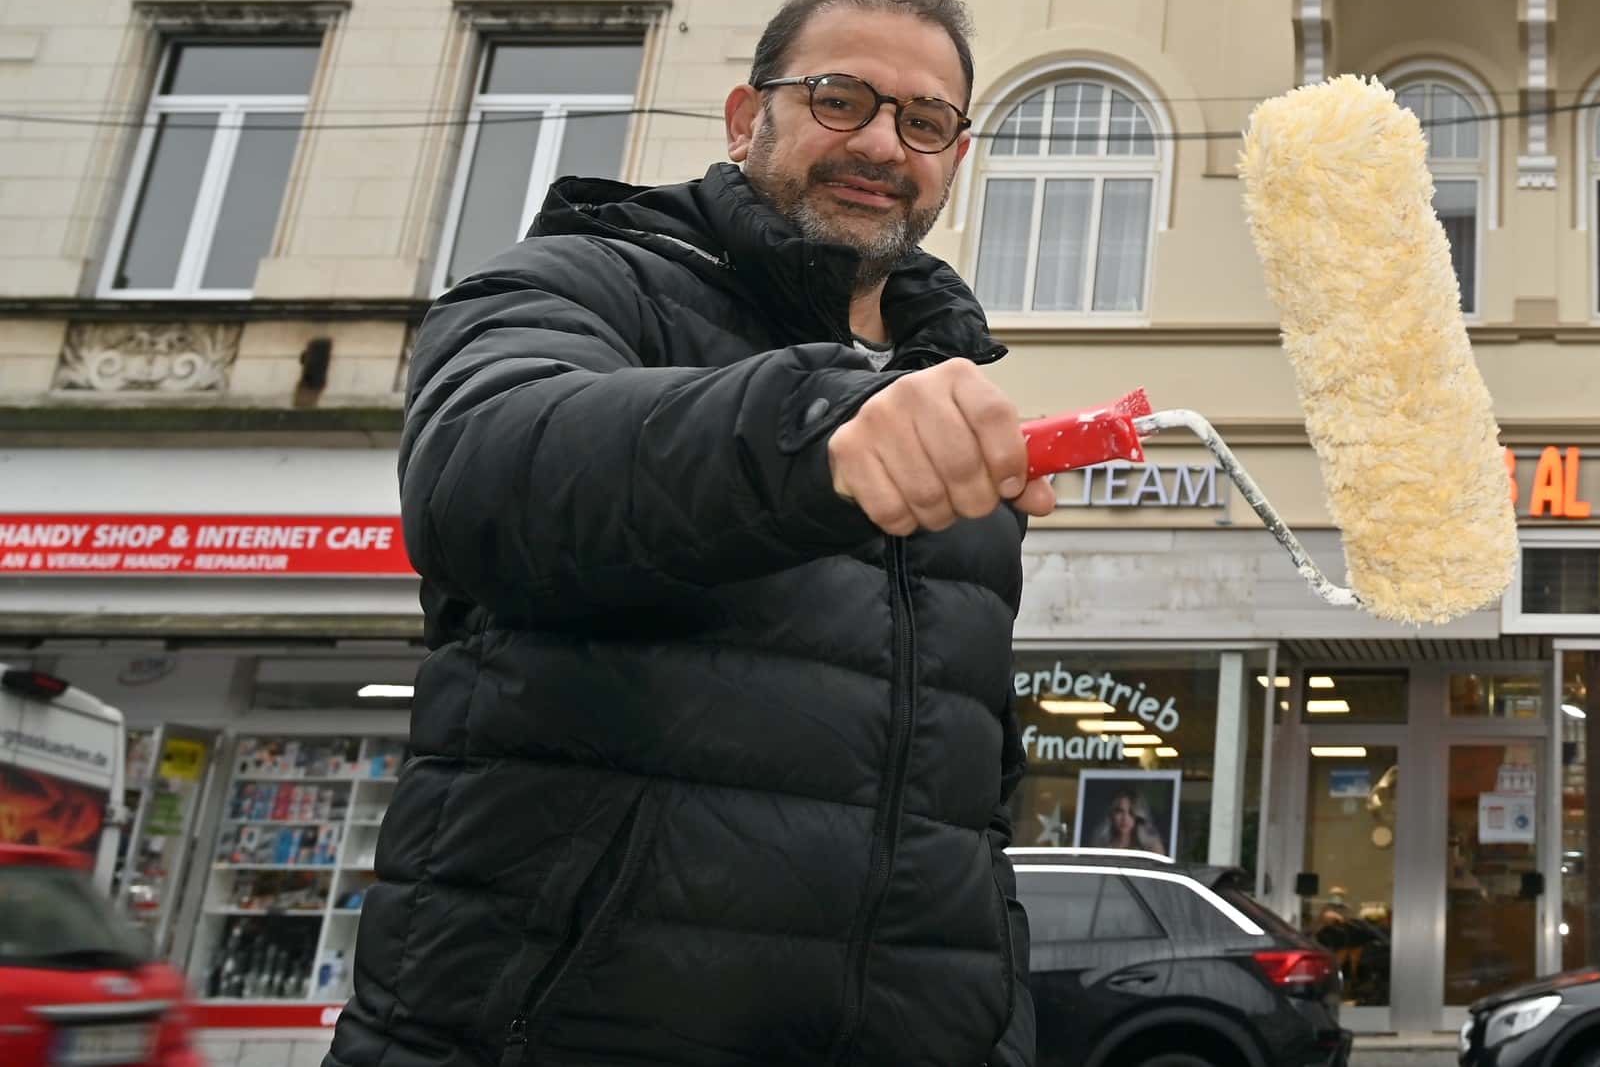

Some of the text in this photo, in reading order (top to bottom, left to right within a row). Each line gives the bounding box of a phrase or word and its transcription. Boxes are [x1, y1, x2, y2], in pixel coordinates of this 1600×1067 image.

[1081, 462, 1217, 506] TEAM
[1530, 446, 1591, 518] AL
[0, 523, 393, 550] HANDY SHOP & INTERNET CAFE
[194, 554, 289, 571] REPARATUR
[1014, 661, 1180, 733] erbetrieb
